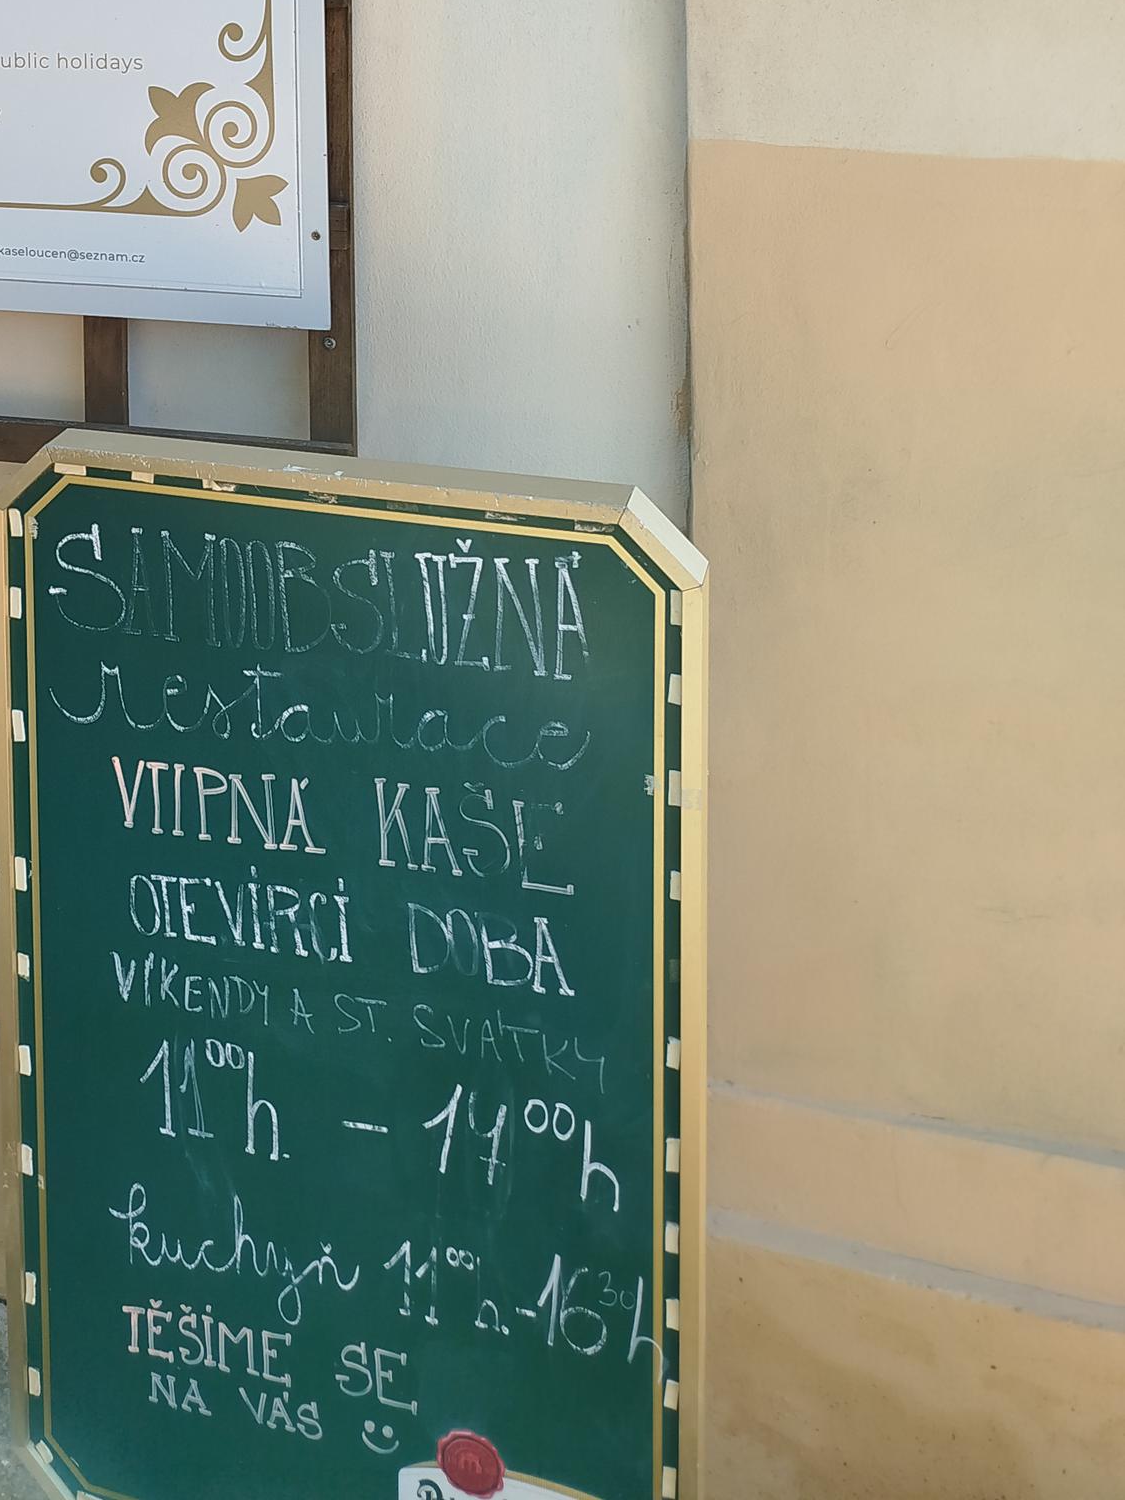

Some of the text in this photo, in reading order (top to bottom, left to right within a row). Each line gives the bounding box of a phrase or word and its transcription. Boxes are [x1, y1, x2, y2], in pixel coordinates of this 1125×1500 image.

[57, 52, 144, 75] holidays
[48, 662, 591, 771] restaurace
[111, 756, 575, 896] VTIPNÁ KAŠE
[407, 902, 575, 997] DOBA
[289, 987, 316, 1034] A
[121, 1298, 419, 1416] TĚŠÍME SE
[148, 1370, 324, 1441] NA VÁS
